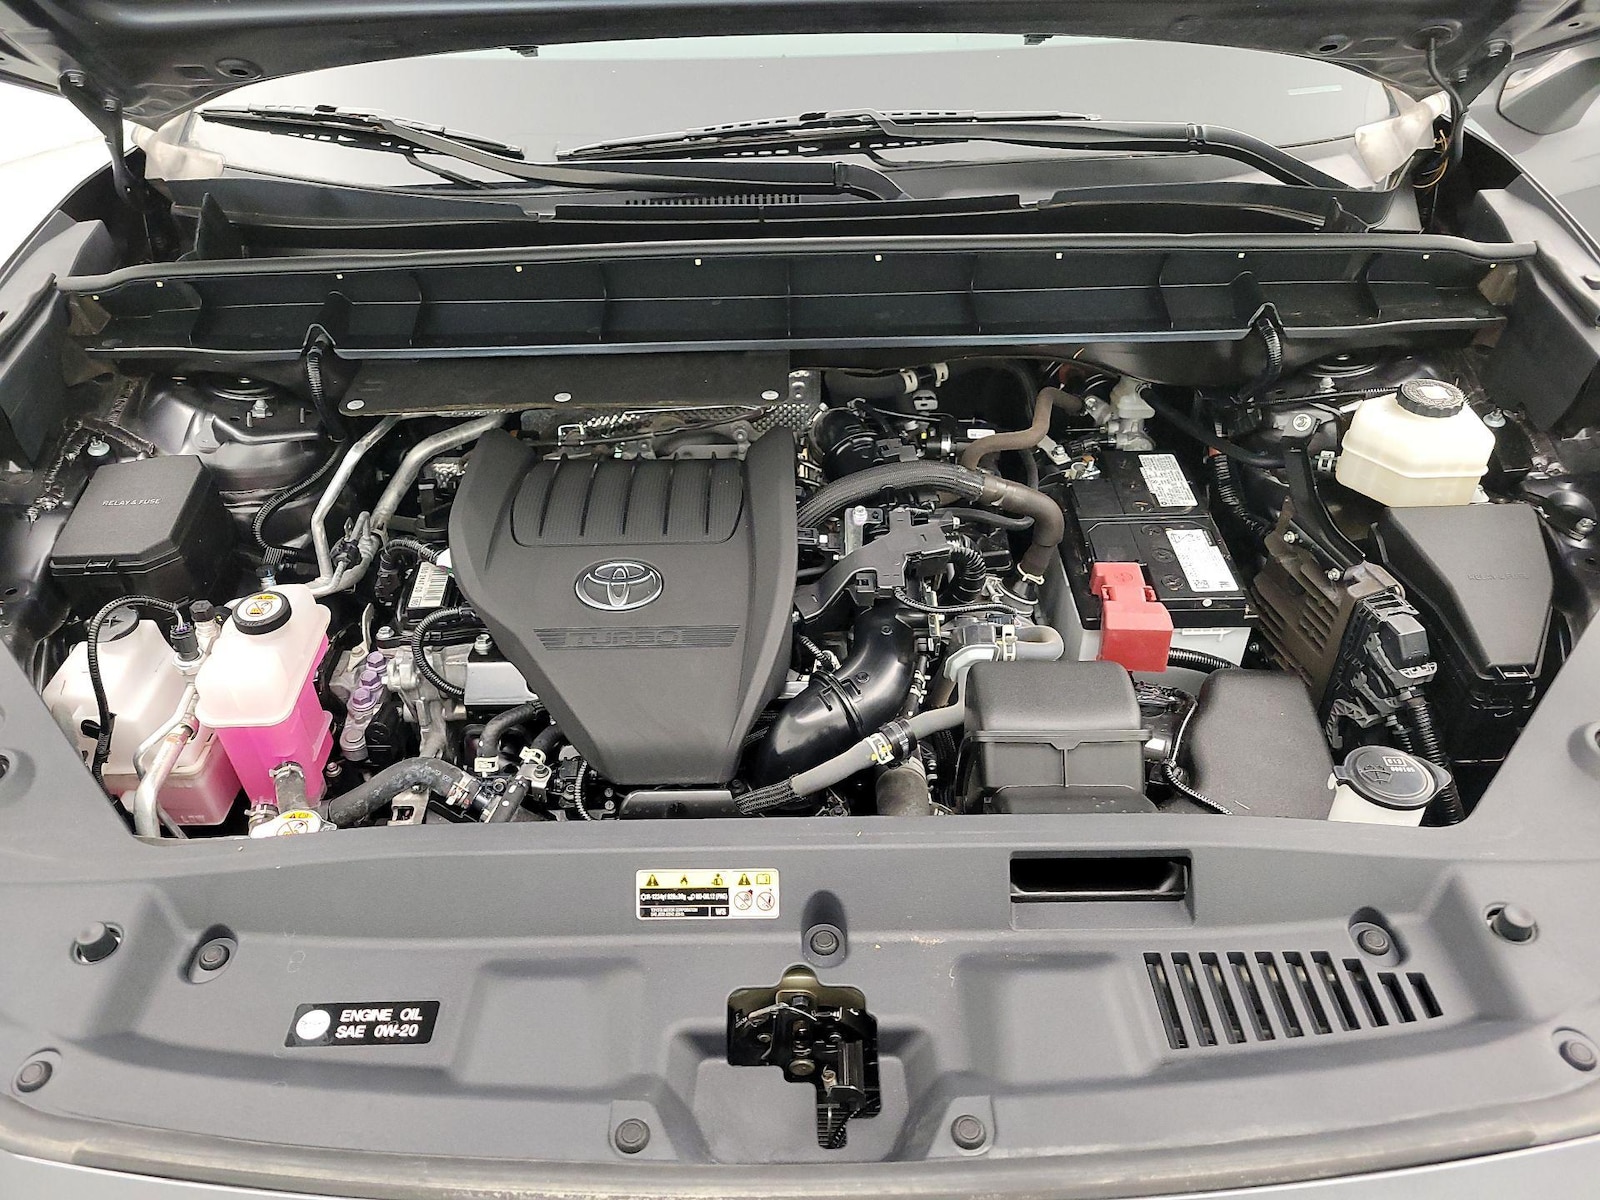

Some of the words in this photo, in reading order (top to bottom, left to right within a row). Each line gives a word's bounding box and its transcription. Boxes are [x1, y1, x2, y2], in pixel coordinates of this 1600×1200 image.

[567, 630, 679, 646] TURBO
[339, 1009, 393, 1023] ENGINE
[399, 1007, 423, 1022] OIL
[335, 1025, 367, 1039] SAE
[373, 1023, 419, 1038] 0W-20
